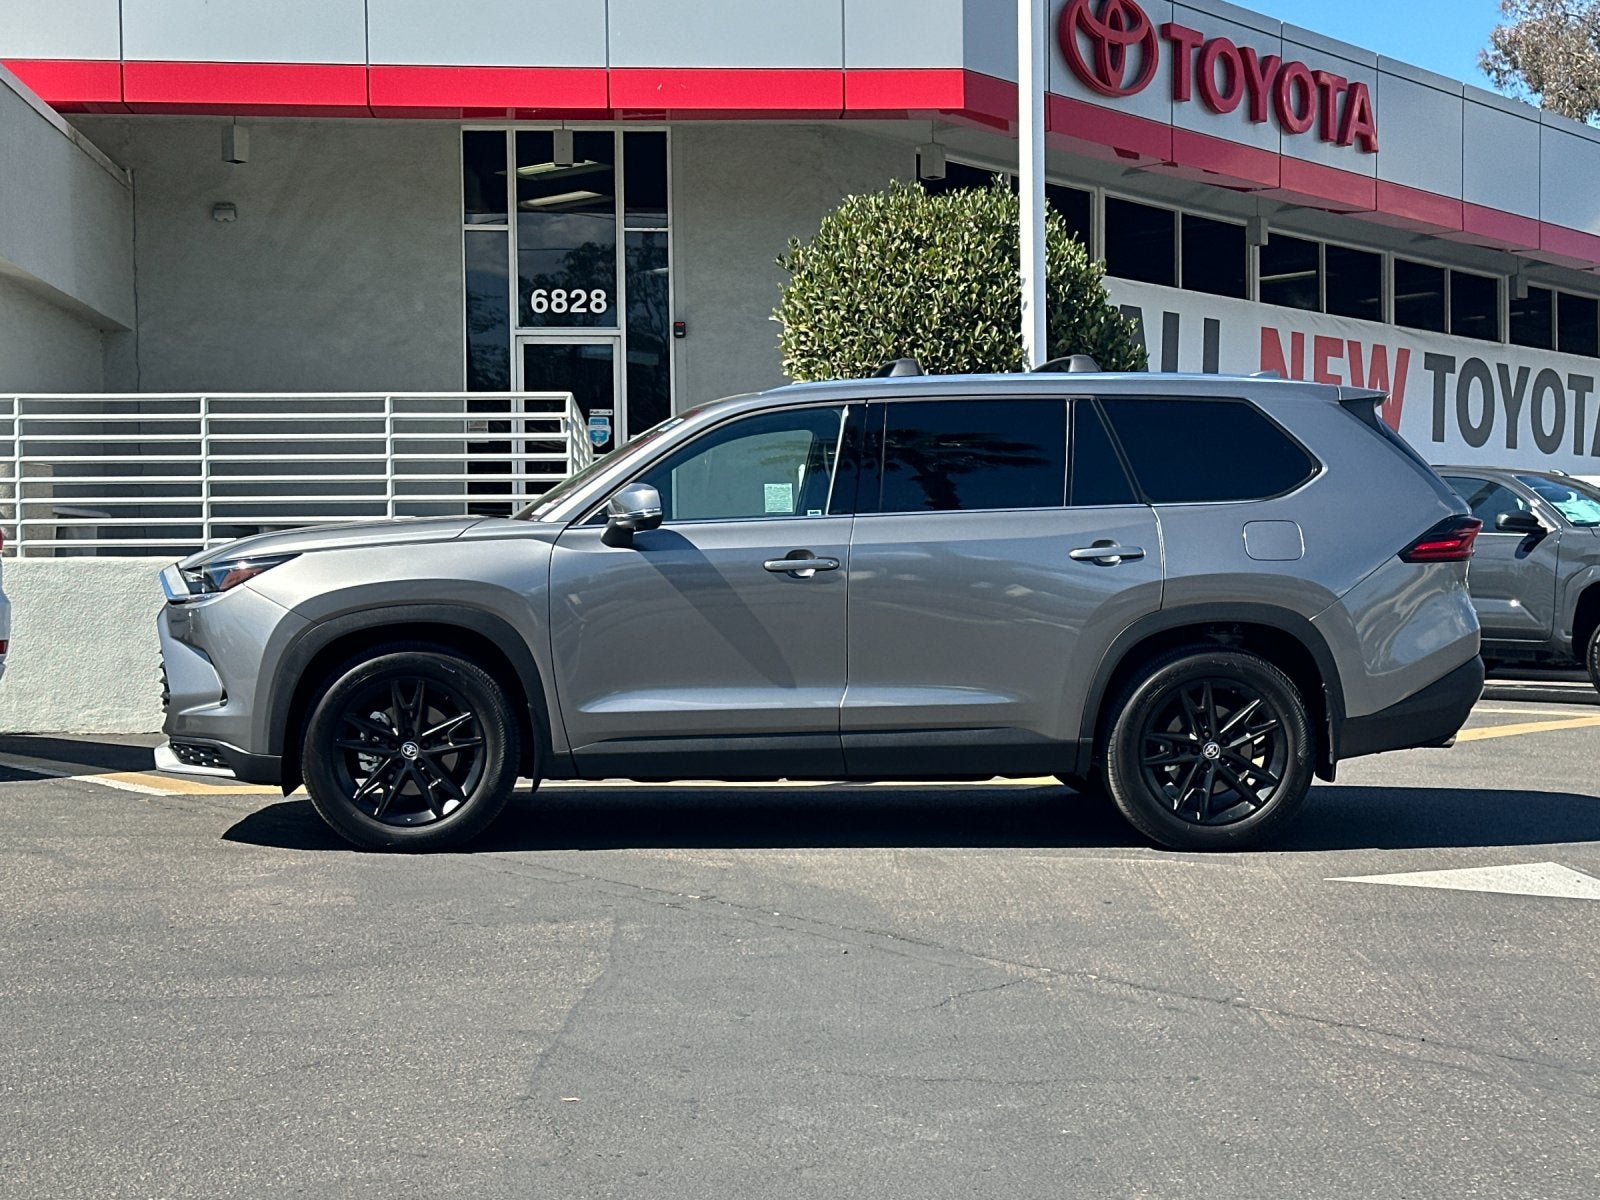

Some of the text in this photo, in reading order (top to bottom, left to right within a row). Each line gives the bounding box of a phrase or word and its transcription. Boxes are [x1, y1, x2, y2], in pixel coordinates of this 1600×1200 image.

[1161, 22, 1379, 153] TOYOTA
[530, 288, 608, 314] 6828
[1424, 352, 1600, 457] TOYOT
